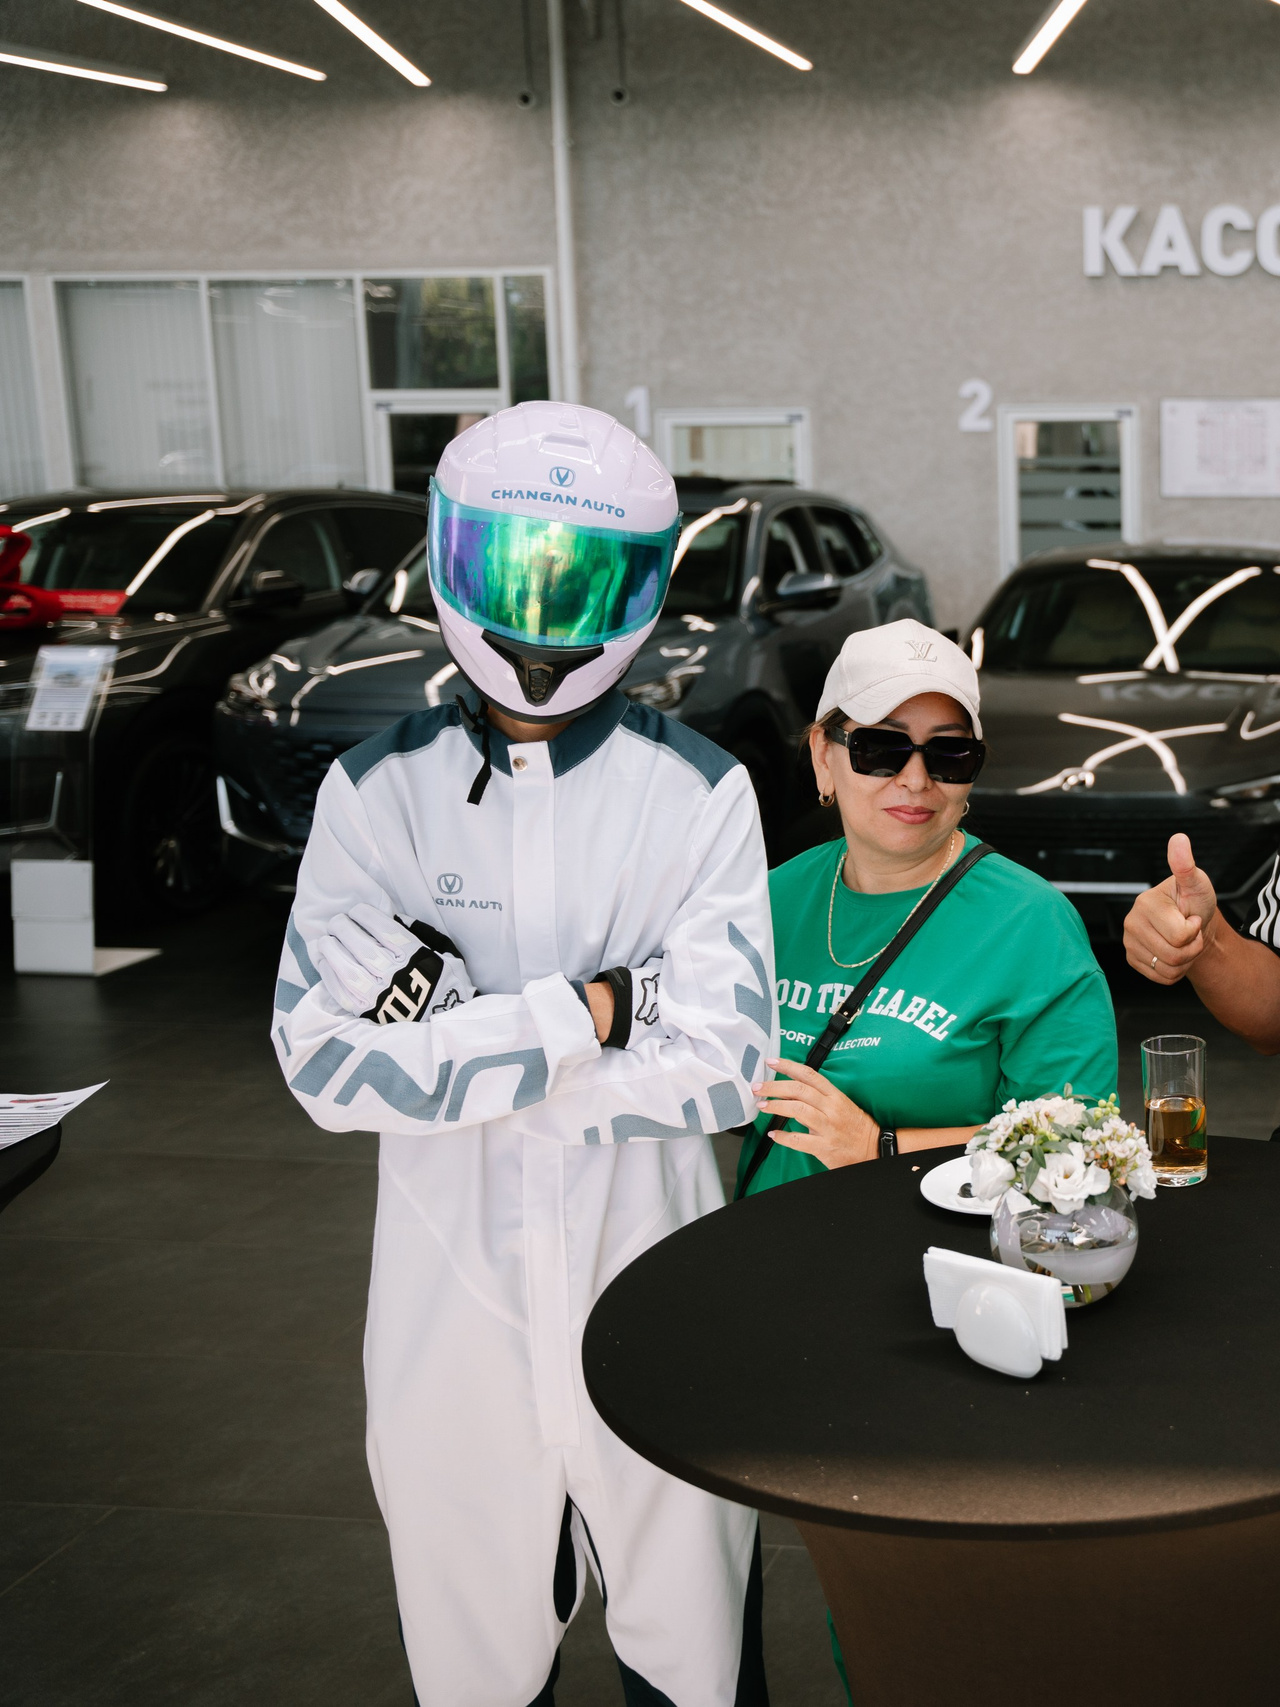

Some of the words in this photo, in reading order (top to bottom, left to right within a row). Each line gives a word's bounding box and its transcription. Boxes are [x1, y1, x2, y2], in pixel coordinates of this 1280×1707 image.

[625, 386, 649, 437] 1
[958, 379, 993, 432] 2
[491, 489, 578, 506] CHANGAN
[581, 499, 626, 519] AUTO
[866, 986, 958, 1042] LABEL
[779, 1028, 816, 1047] PORT
[831, 1036, 881, 1052] LLECTION
